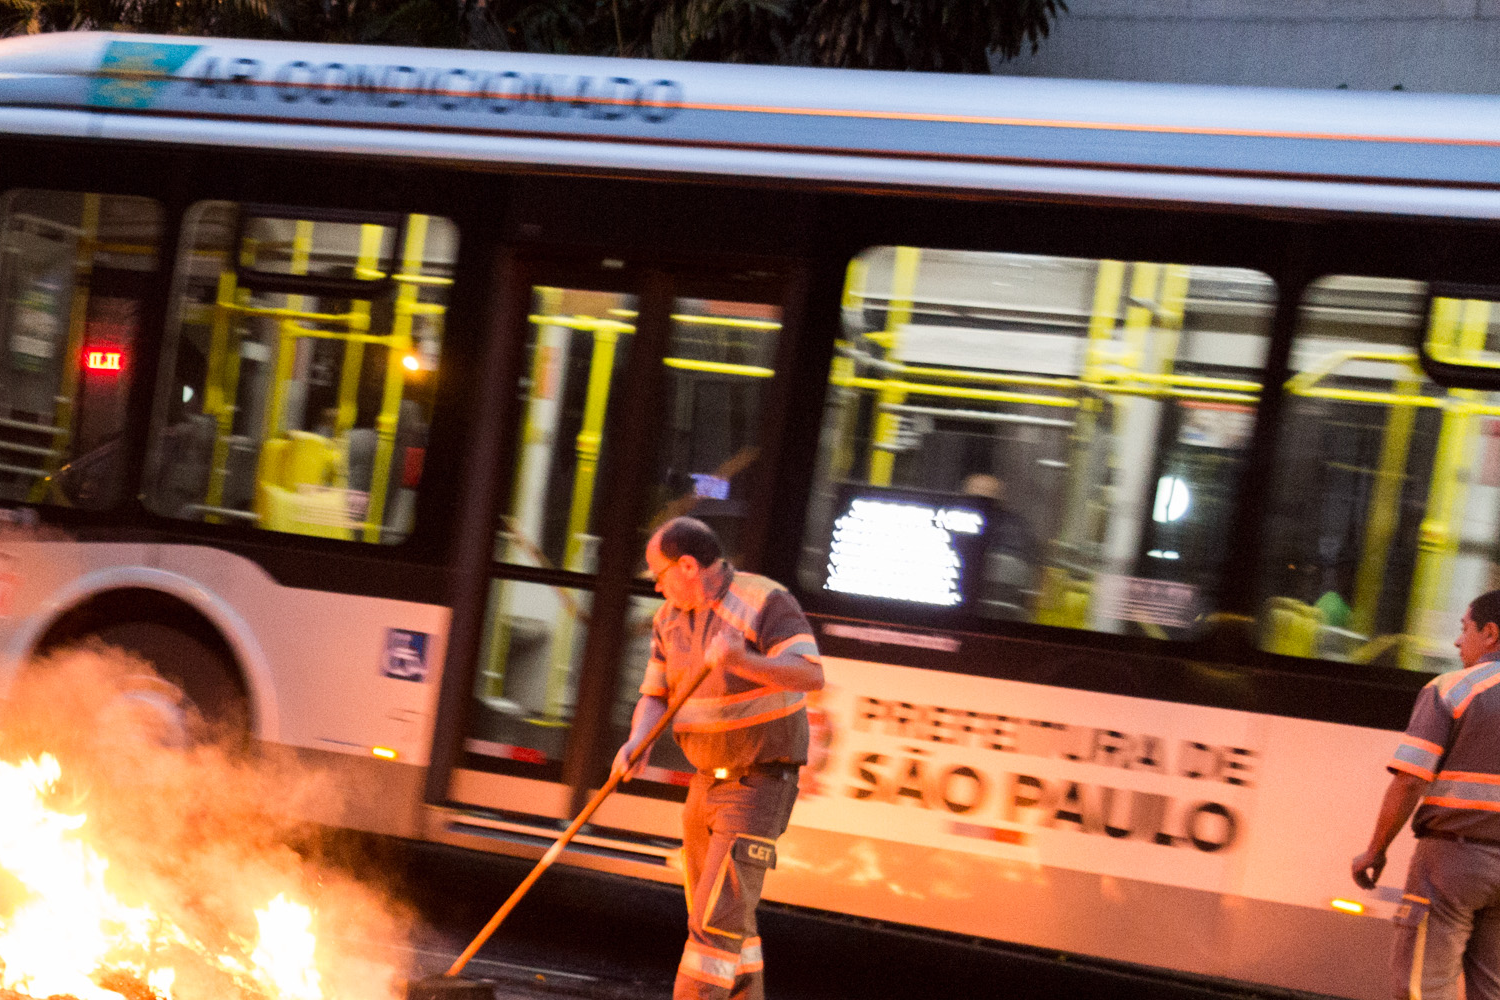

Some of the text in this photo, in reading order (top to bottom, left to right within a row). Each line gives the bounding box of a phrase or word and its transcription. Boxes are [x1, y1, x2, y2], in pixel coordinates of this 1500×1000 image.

[192, 56, 686, 124] AR CONDICIONADO
[854, 696, 1256, 788] PREFEITURA DE
[850, 745, 1242, 853] SÃO PAULO
[747, 843, 772, 862] CET
